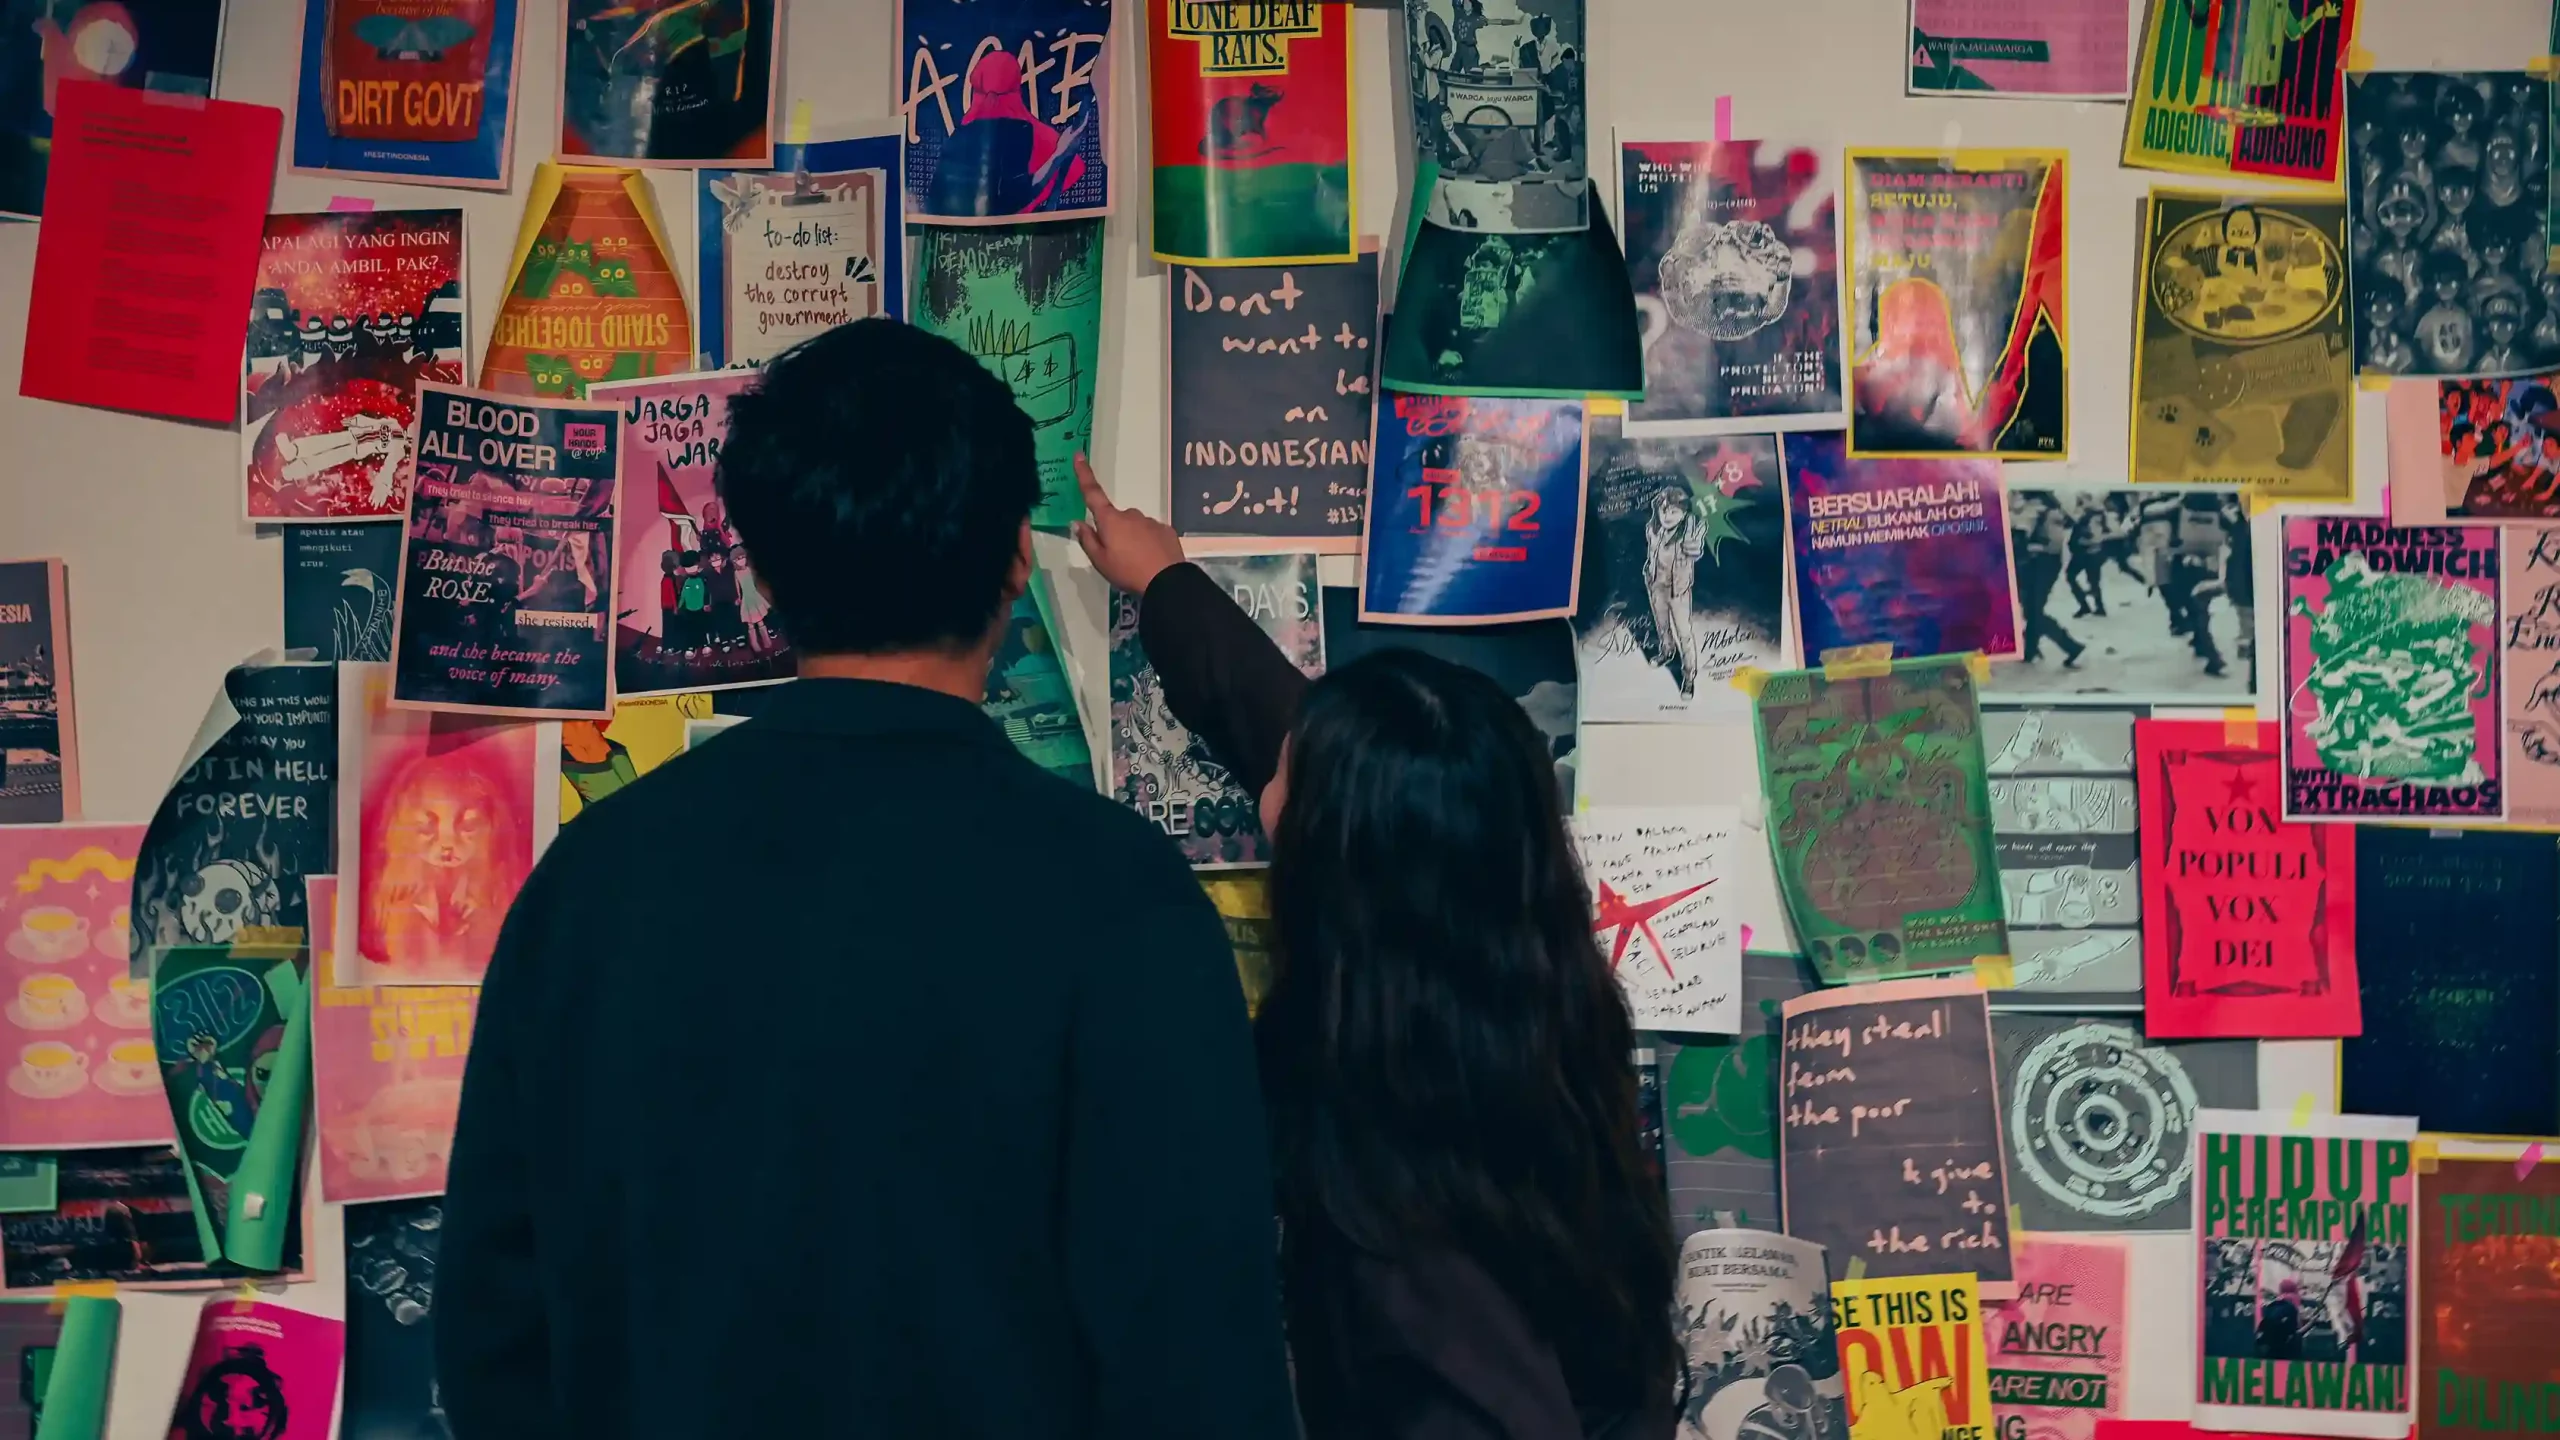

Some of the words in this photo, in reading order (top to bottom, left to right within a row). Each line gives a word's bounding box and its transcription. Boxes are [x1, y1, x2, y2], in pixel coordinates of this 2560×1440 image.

[1213, 33, 1284, 66] RATS.
[339, 80, 399, 125] DIRT
[403, 80, 483, 127] GOVT
[346, 233, 395, 248] YANG
[401, 231, 450, 246] INGIN
[763, 220, 809, 248] to-do
[815, 222, 838, 246] list:
[270, 260, 323, 275] ANDA
[331, 258, 391, 275] AMBIL,
[765, 260, 829, 285] destroy
[744, 283, 775, 305] the
[784, 282, 848, 305] corrupt
[1184, 268, 1304, 316] Dont
[757, 308, 852, 334] government
[1222, 324, 1322, 354] want
[1334, 322, 1368, 349] to
[447, 400, 539, 438] BLOOD
[1285, 406, 1328, 422] an
[643, 423, 703, 443] JAGA
[421, 430, 472, 462] ALL
[479, 438, 557, 471] OVER
[1184, 437, 1369, 468] INDONESIAN
[1407, 485, 1541, 531] 1312
[1808, 480, 1981, 518] BERSUARALAH!
[1867, 506, 1946, 528] BUKANLAH
[1864, 525, 1929, 545] MEMIHAK
[2317, 524, 2464, 548] MADNESS
[464, 552, 497, 576] she
[422, 577, 496, 604] ROSE.
[518, 614, 539, 625] she
[429, 641, 462, 658] and
[463, 644, 488, 660] she
[490, 644, 551, 665] became
[554, 648, 581, 666] the
[449, 664, 486, 682] voice
[490, 667, 509, 688] of
[509, 672, 561, 691] many.
[283, 737, 306, 750] YOU
[177, 792, 308, 820] FOREVER
[2290, 781, 2499, 809] EXTRACHAOS
[2204, 806, 2277, 834] VOX
[2179, 851, 2308, 880] POPULI
[2206, 895, 2279, 924] VOX
[2215, 940, 2273, 968] DEI
[1788, 1022, 1851, 1058] they
[1862, 1009, 1942, 1045] steal
[1787, 1099, 1841, 1127] the
[1851, 1098, 1912, 1138] poor
[1931, 1158, 1994, 1195] give
[2206, 1134, 2410, 1201] HIDUP
[1962, 1190, 1996, 1215] to
[1867, 1226, 1929, 1253] the
[1941, 1221, 2001, 1250] rich
[1867, 1290, 1933, 1326] THIS
[1943, 1288, 1969, 1322] IS
[2016, 1283, 2075, 1306] ARE
[2002, 1321, 2109, 1353] ANGRY
[1989, 1374, 2045, 1399] ARE
[2047, 1378, 2107, 1403] NOT
[2203, 1356, 2408, 1412] MELAWAN!
